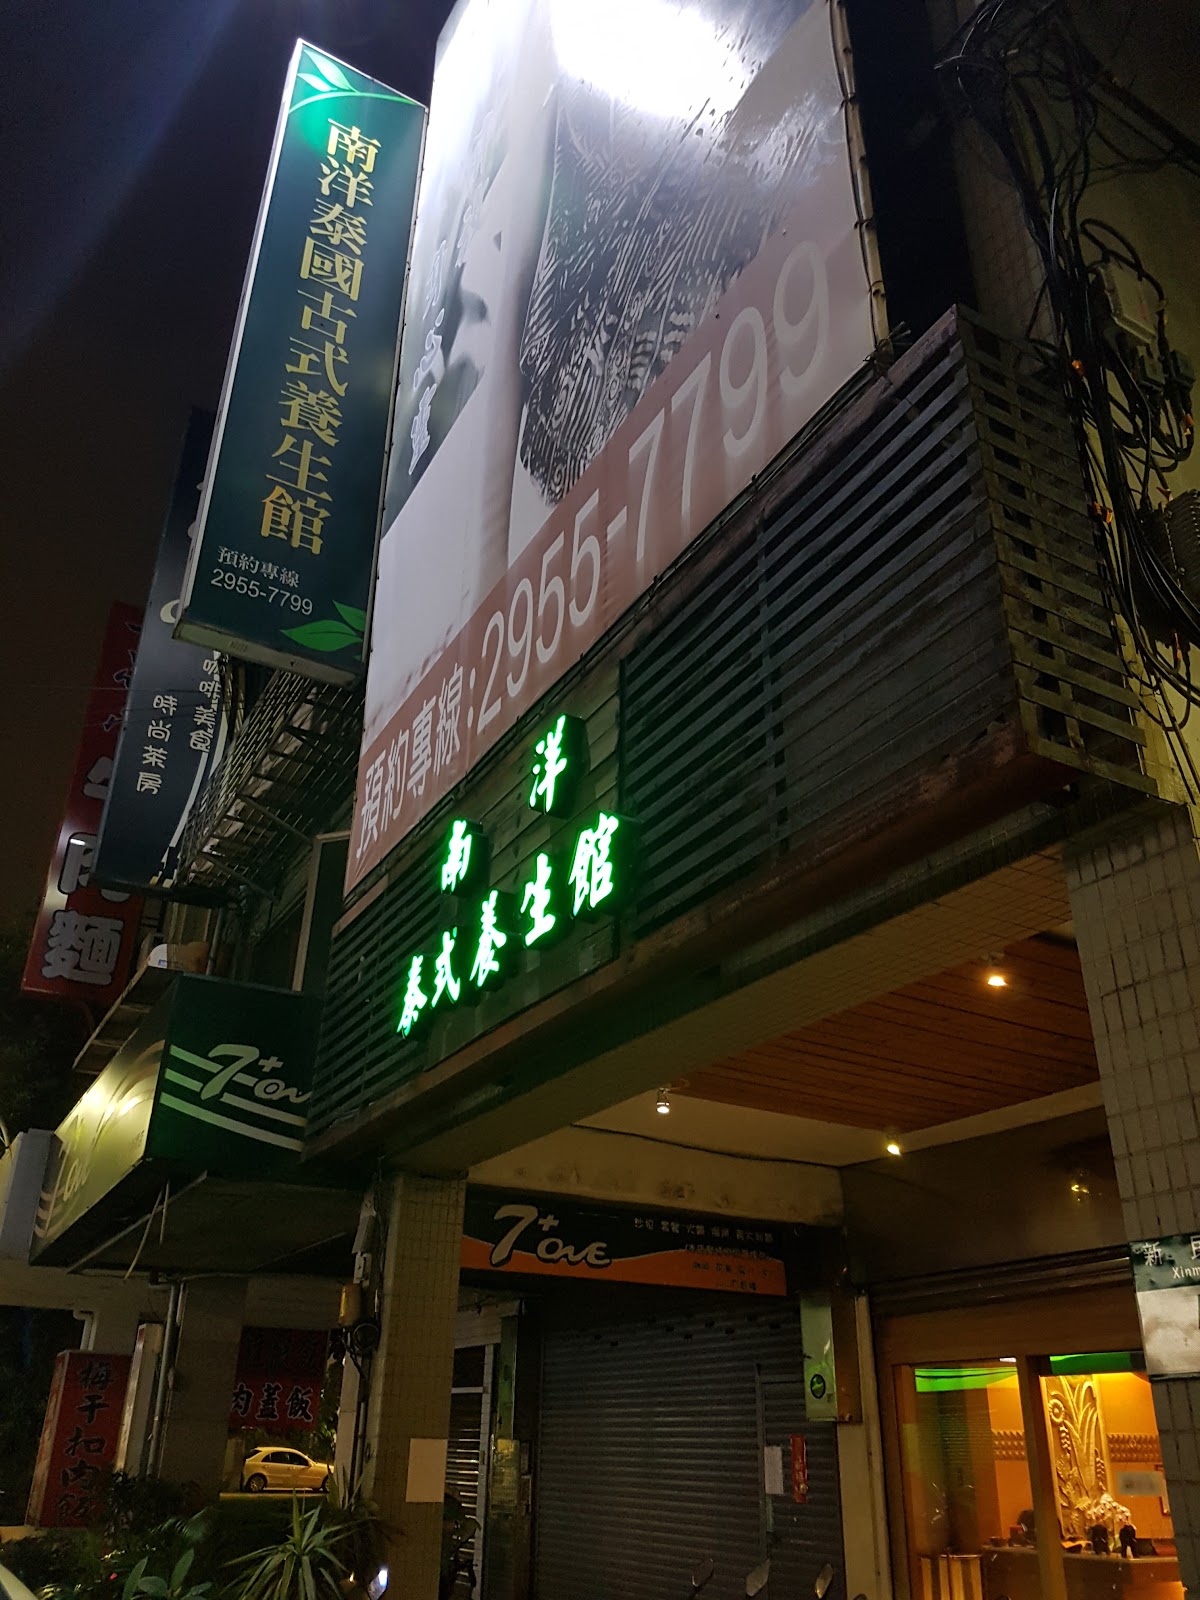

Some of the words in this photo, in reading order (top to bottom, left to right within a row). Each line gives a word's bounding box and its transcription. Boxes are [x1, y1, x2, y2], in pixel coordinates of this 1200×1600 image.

[260, 117, 383, 556] 南洋泰國古式養生館
[210, 568, 313, 615] 2955-7799
[217, 545, 300, 588] 預約專線
[136, 694, 178, 796] 時尚茶房
